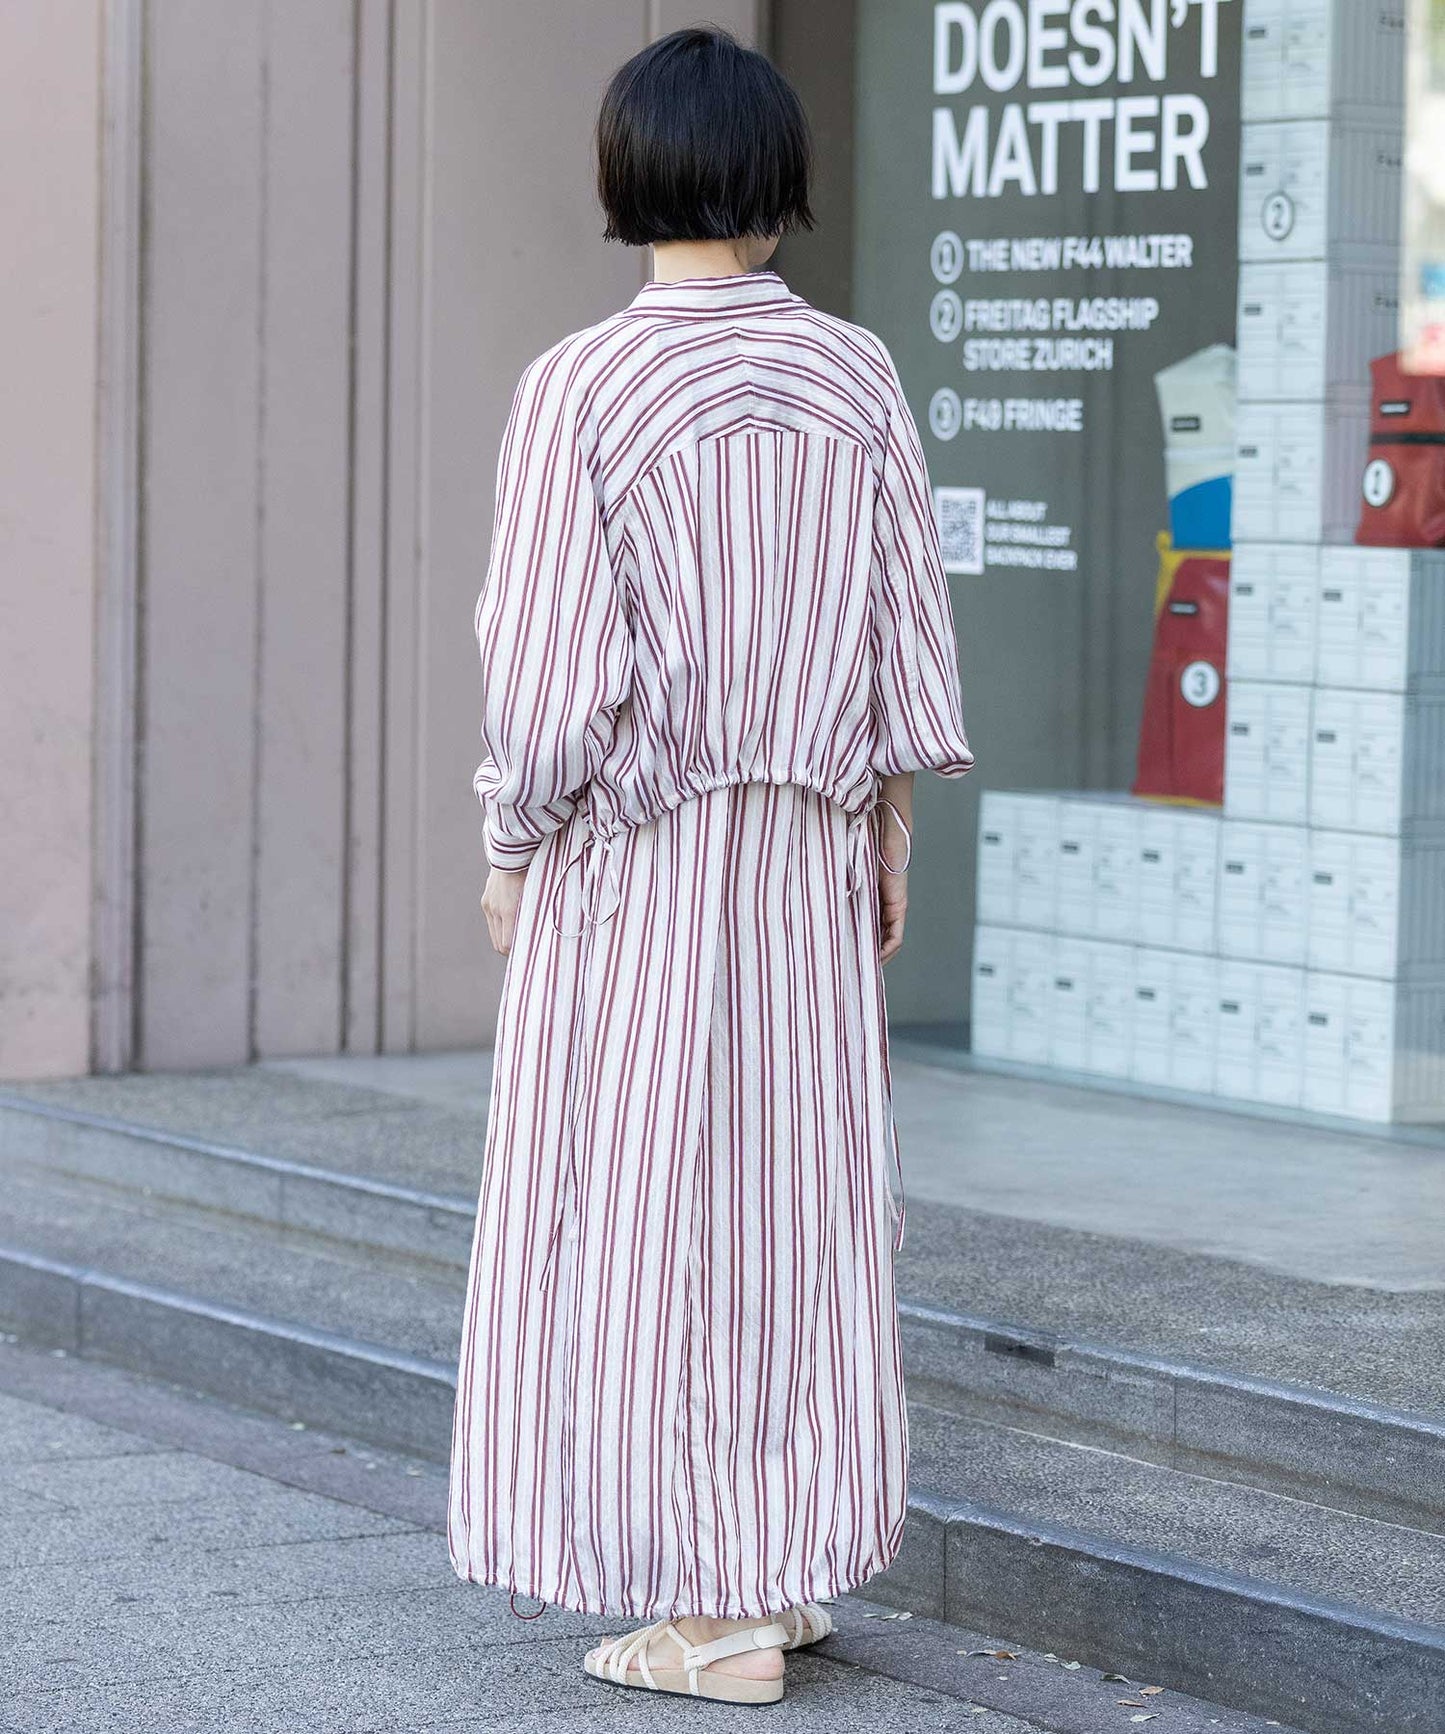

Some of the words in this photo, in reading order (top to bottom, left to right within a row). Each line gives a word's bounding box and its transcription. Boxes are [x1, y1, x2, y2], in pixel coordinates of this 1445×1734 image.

[932, 0, 1232, 95] DOESN'T
[931, 94, 1210, 200] MATTER
[966, 239, 1009, 271] THE
[1010, 238, 1060, 271] NEW
[1062, 236, 1103, 269] F44
[1103, 234, 1193, 268] WALTER
[964, 299, 1049, 332] FREITAG
[1052, 297, 1160, 331] FLAGSHIP
[963, 338, 1031, 371] STORE
[1032, 338, 1114, 371] ZURICH
[1003, 398, 1083, 431] FRINGE
